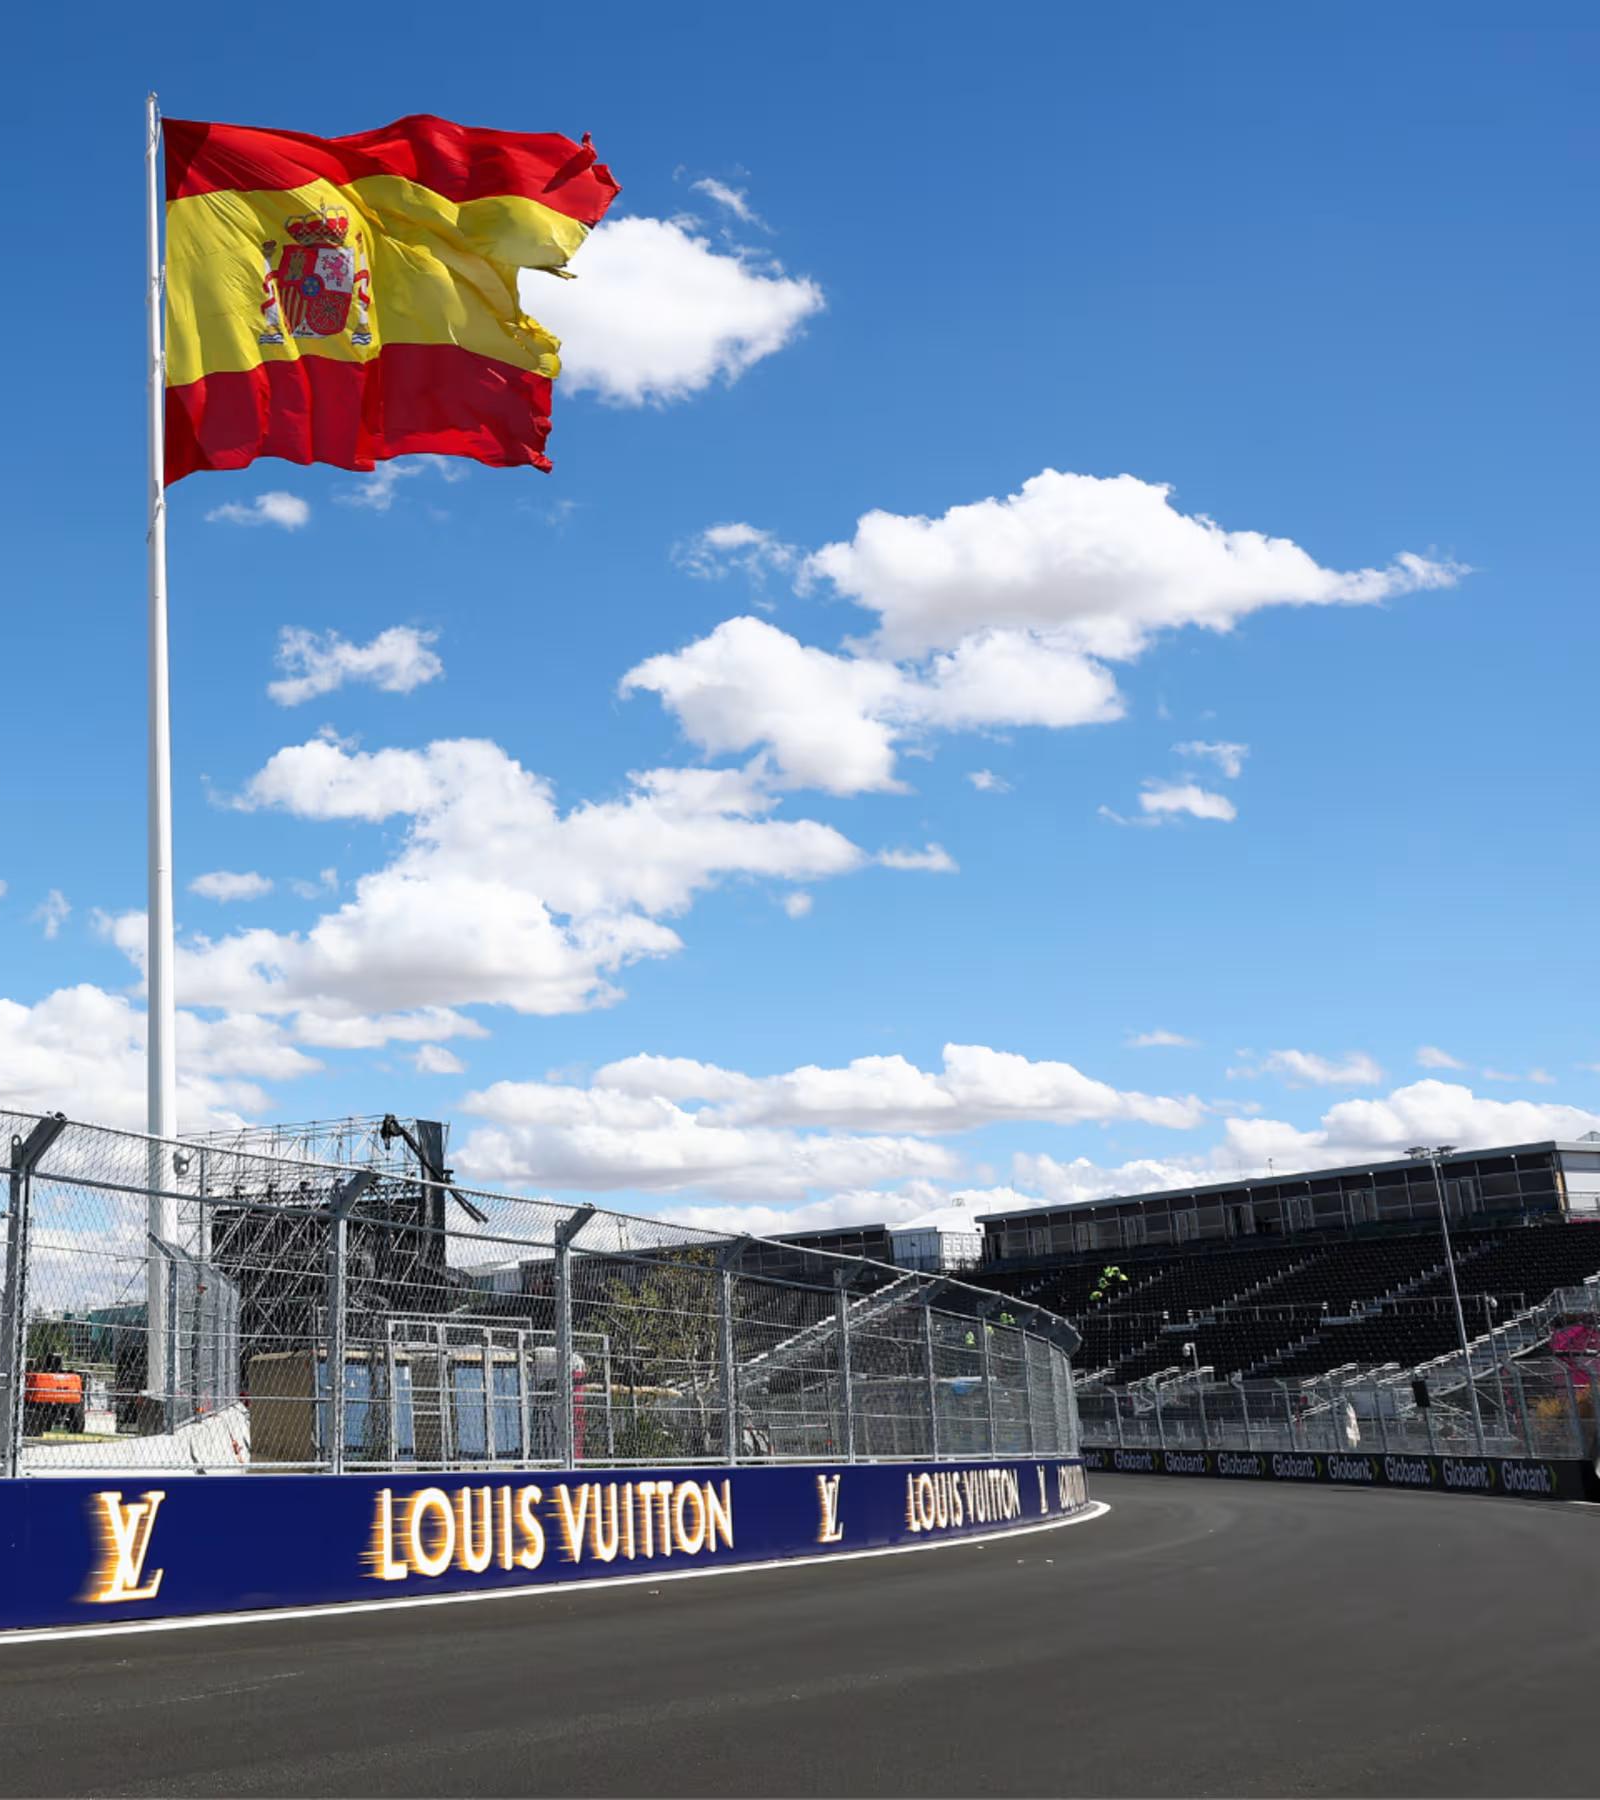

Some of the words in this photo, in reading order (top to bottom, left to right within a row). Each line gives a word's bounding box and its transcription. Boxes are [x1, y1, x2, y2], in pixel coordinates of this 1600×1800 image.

[378, 1484, 546, 1580] LOUIS
[555, 1479, 734, 1564] VUITTON
[907, 1471, 963, 1532] LOUIS
[963, 1468, 1021, 1524] VUITTON
